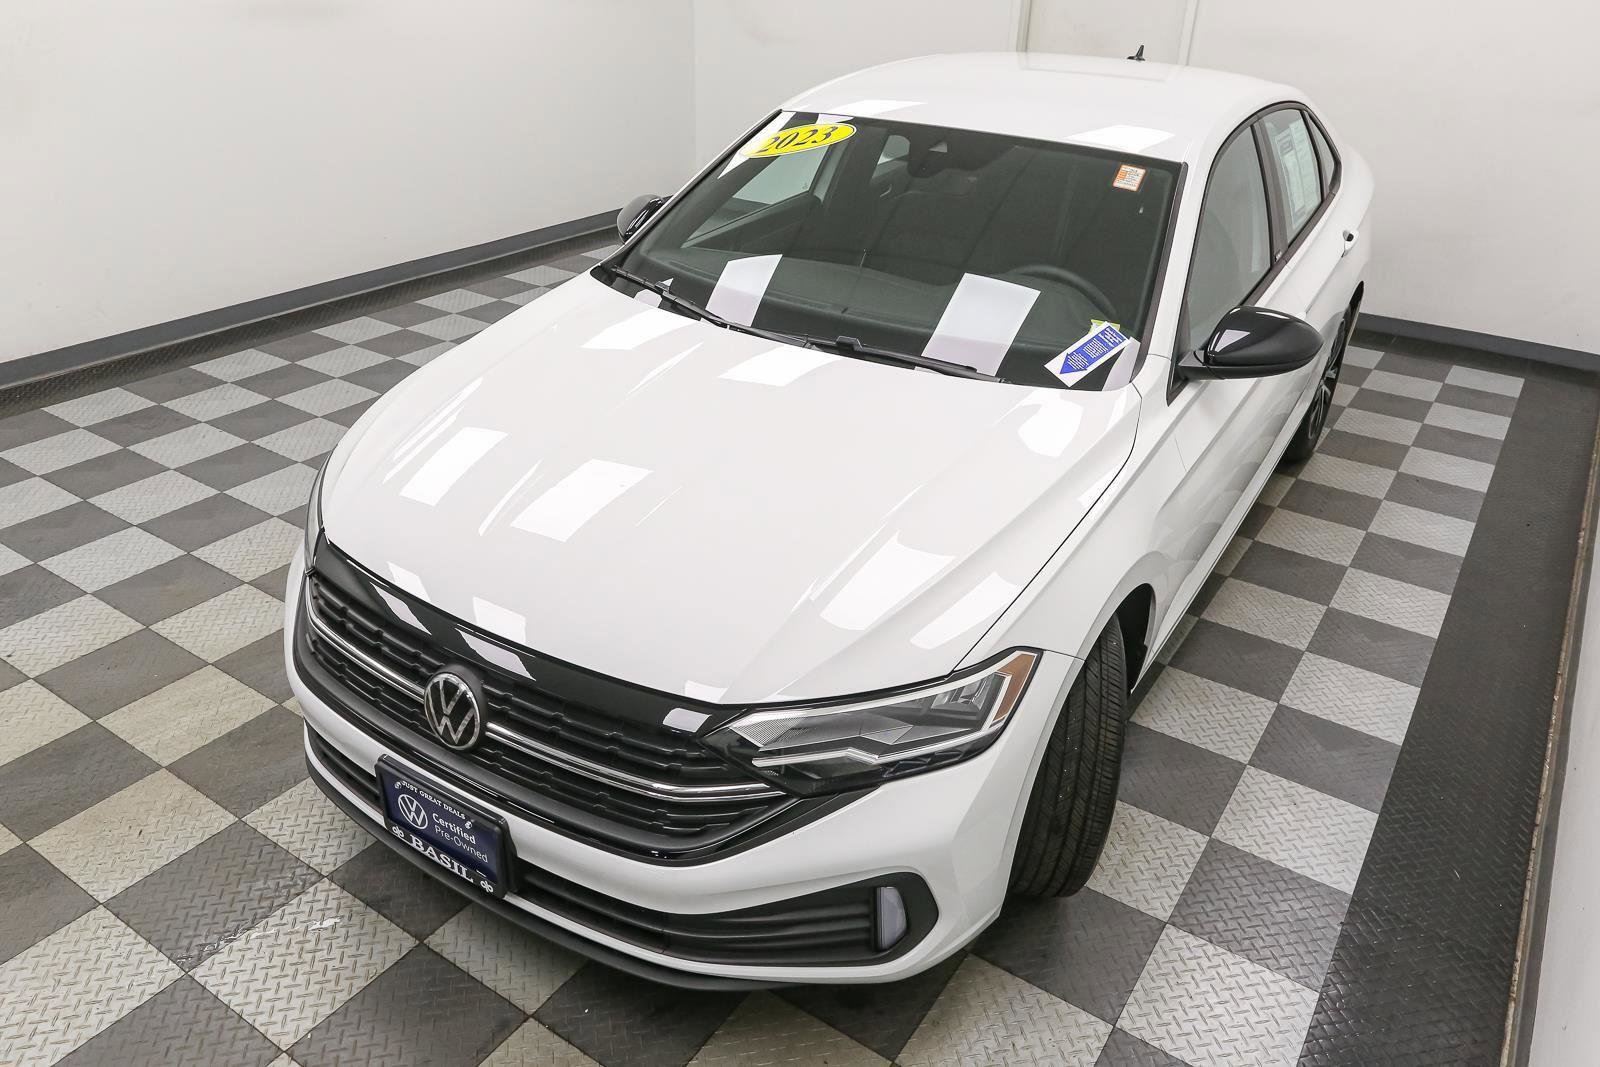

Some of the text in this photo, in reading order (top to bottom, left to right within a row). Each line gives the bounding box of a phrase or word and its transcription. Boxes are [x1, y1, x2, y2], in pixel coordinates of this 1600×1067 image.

[755, 126, 838, 153] 2023
[402, 780, 466, 820] JUST GREAT DEALS
[432, 812, 476, 844] Certified
[434, 824, 488, 863] Pre-Owned
[410, 834, 474, 883] BASIL
